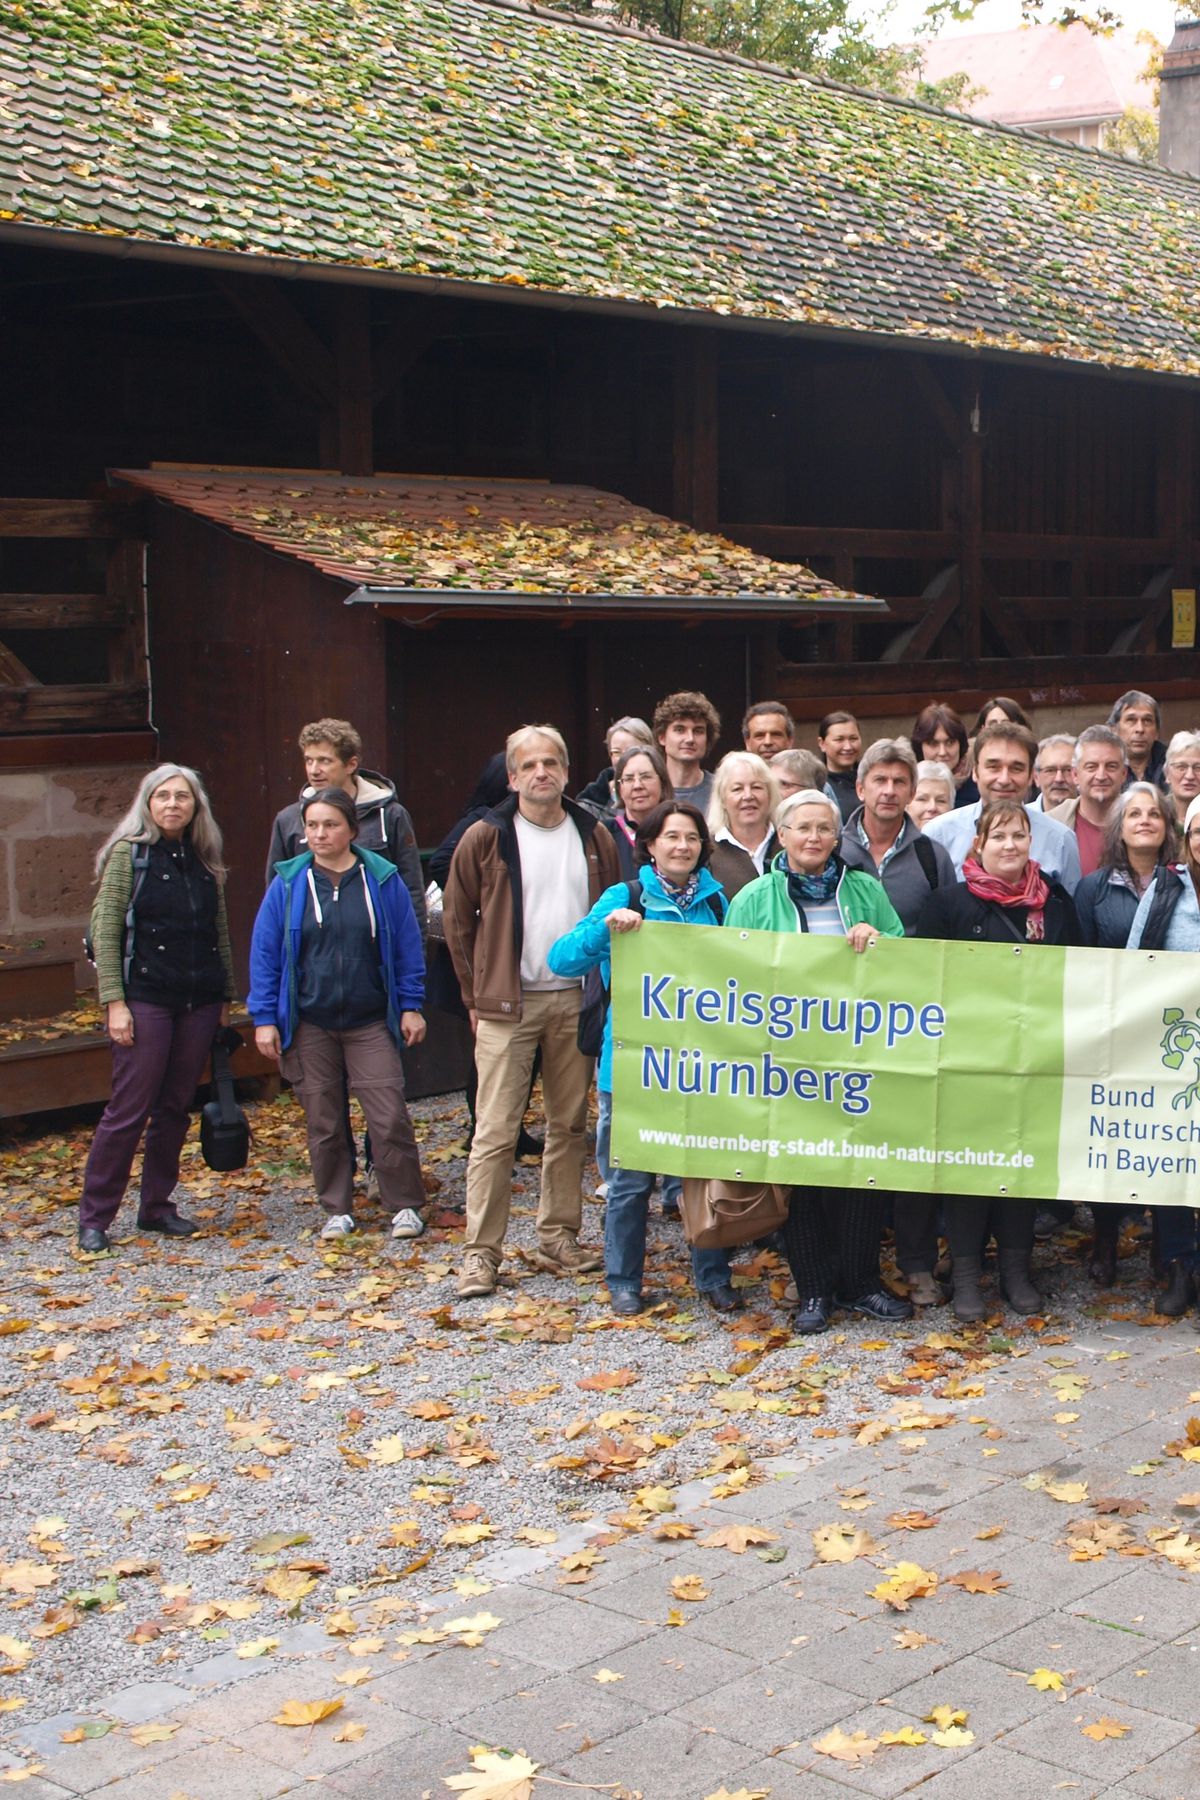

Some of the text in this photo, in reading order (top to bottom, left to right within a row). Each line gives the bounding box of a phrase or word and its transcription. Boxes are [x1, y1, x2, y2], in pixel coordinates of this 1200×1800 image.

[641, 973, 946, 1048] Kreisgruppe
[641, 1046, 874, 1115] Nürnberg
[1090, 1083, 1155, 1108] Bund
[638, 1127, 1034, 1168] www.nuernberg-stadt.bund-naturschutz.de
[1088, 1146, 1107, 1169] in
[1116, 1148, 1196, 1178] Bayern
